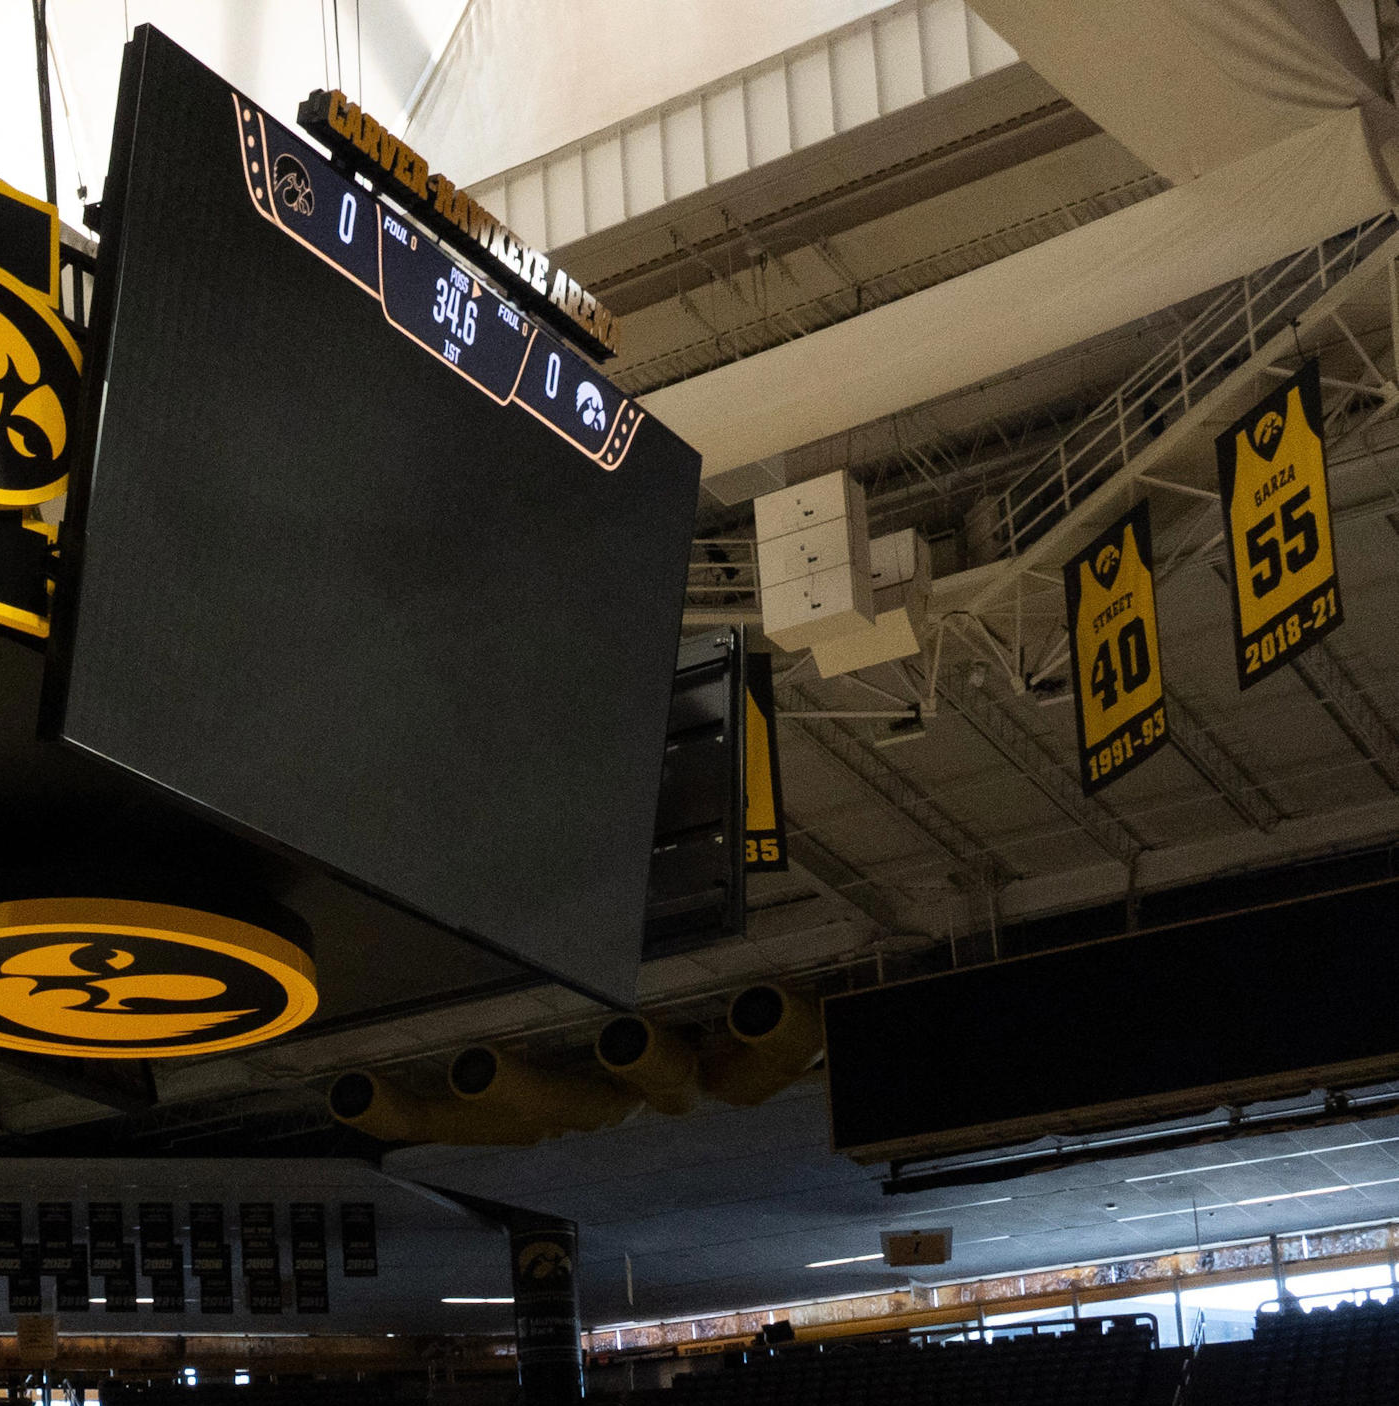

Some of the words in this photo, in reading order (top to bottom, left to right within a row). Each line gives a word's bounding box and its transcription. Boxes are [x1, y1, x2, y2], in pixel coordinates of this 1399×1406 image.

[327, 89, 550, 296] CARVER-HAWKEYE
[338, 192, 357, 244] 0
[383, 216, 408, 246] FOUL
[449, 267, 470, 294] POSS
[432, 277, 478, 346] 34.6
[497, 303, 519, 331] FOUL
[442, 339, 462, 365] 1ST
[545, 352, 561, 399] 0
[1253, 464, 1296, 508] GARZA
[1245, 484, 1319, 600] 55
[1092, 592, 1134, 635] STREET
[1244, 589, 1338, 676] 2018-21
[1091, 615, 1152, 710] 40
[1088, 705, 1167, 783] 1991-93
